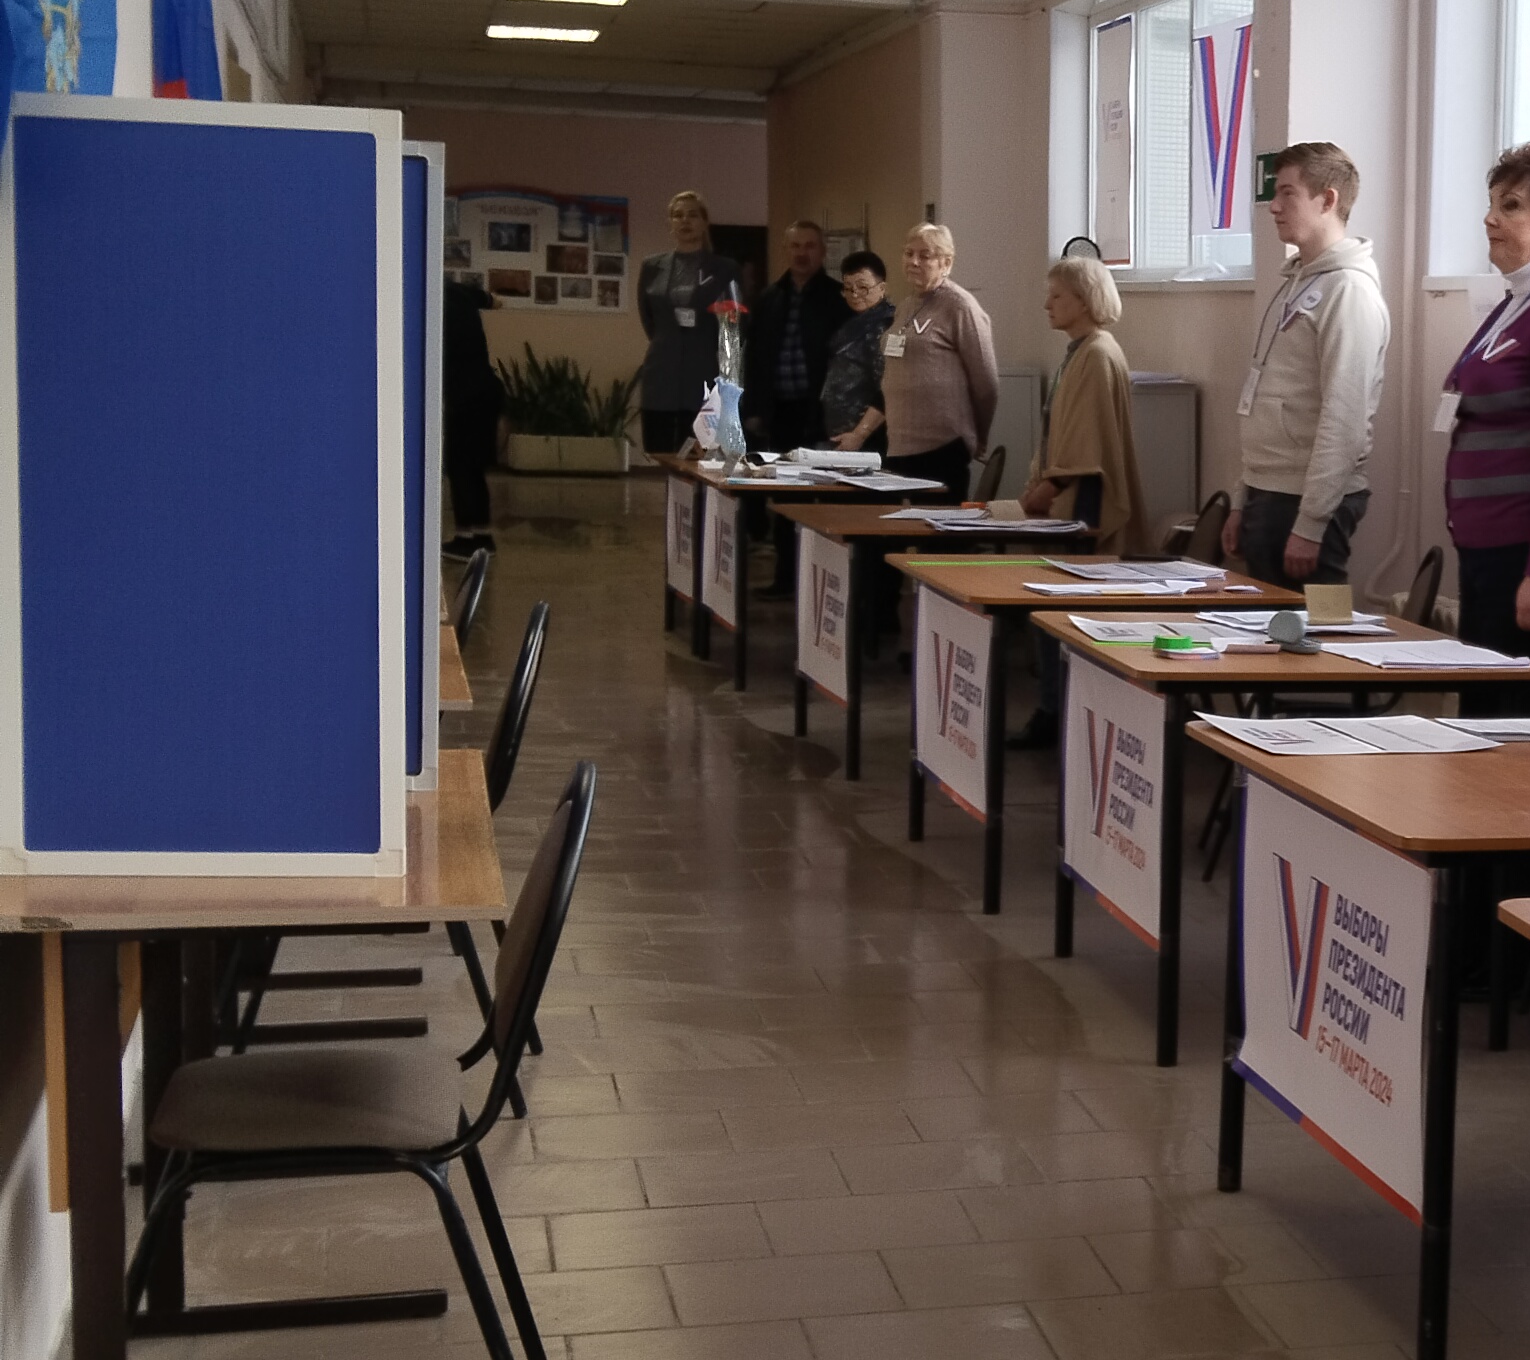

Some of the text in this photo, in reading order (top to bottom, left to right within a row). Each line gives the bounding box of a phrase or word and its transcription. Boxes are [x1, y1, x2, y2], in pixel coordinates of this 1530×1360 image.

[1333, 893, 1389, 957] ВЫБОРЫ
[1328, 938, 1406, 1021] ПРЕЗИДЕНТА
[1322, 982, 1371, 1045] РОССИИ
[1339, 1043, 1369, 1089] МАРТА
[1368, 1066, 1393, 1107] 2024
